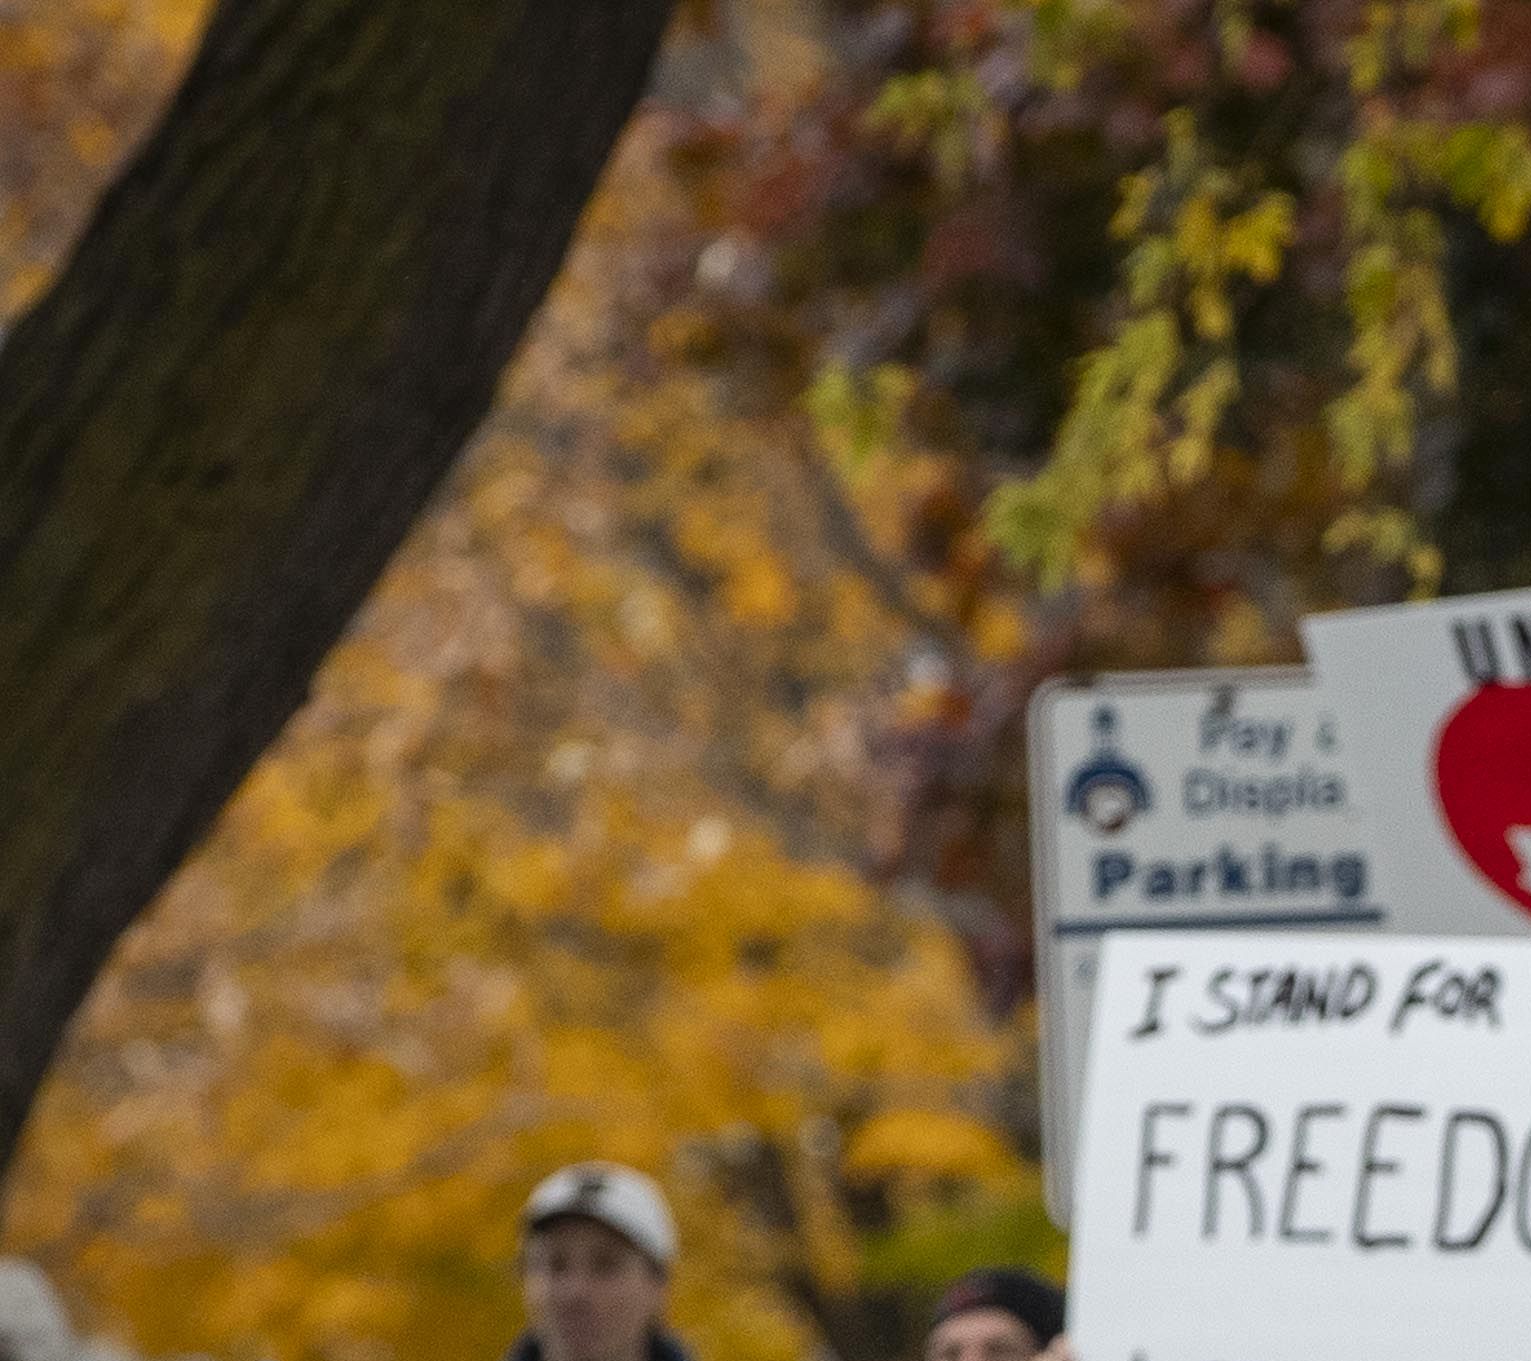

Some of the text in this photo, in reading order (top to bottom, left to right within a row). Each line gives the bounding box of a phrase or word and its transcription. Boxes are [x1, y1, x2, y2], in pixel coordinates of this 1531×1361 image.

[1183, 766, 1346, 818] Displa
[1091, 844, 1367, 904] Parking
[1126, 959, 1506, 1043] I STAND FOR
